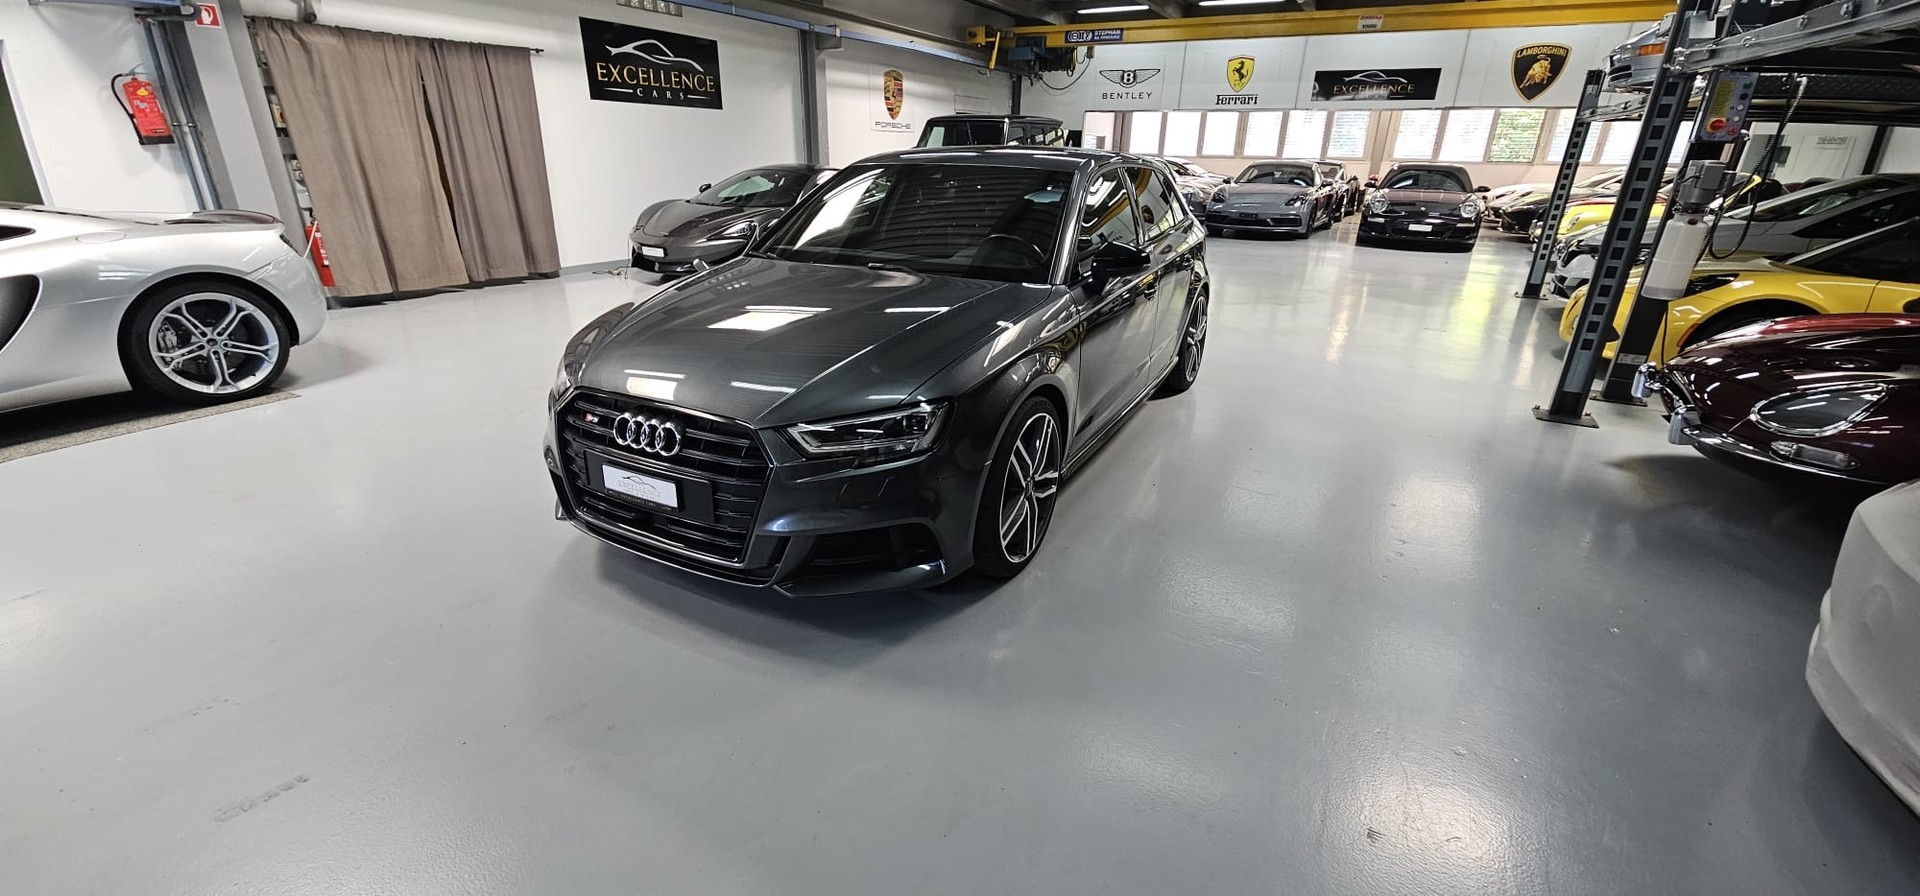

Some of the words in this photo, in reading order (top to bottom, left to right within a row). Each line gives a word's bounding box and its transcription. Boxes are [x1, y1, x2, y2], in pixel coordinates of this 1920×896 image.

[1516, 46, 1567, 58] LAMBORGHINI
[596, 61, 715, 92] EXCELLENCE
[636, 88, 684, 100] CARS
[1333, 83, 1415, 95] EXCELLENCE
[1102, 91, 1153, 100] BENTLEY
[1215, 94, 1259, 105] Ferrari
[875, 121, 911, 130] PORSCHE
